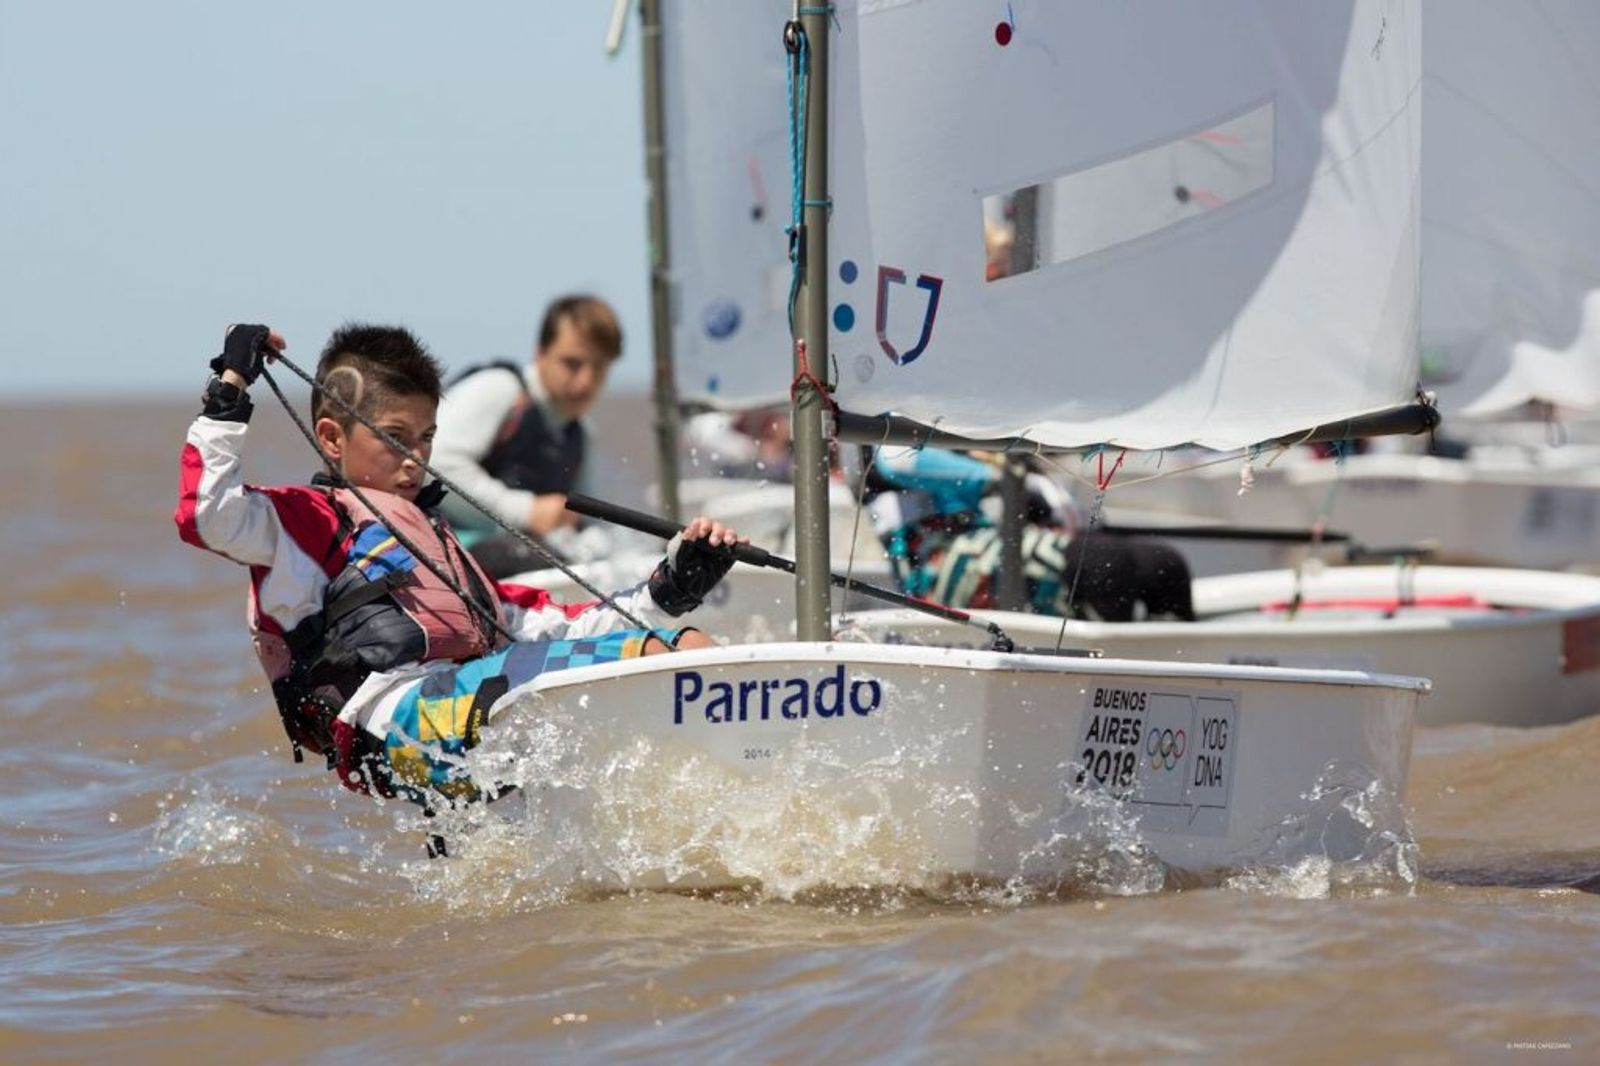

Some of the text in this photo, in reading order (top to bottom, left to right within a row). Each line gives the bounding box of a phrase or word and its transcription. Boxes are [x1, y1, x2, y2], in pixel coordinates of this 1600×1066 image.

[673, 664, 882, 725] Parrado
[1094, 688, 1147, 712] BUENOS
[1085, 715, 1142, 745] AIRES
[1202, 718, 1228, 750] YOG
[744, 748, 772, 760] 2014
[1076, 748, 1136, 787] 2018
[1194, 756, 1222, 788] DNA
